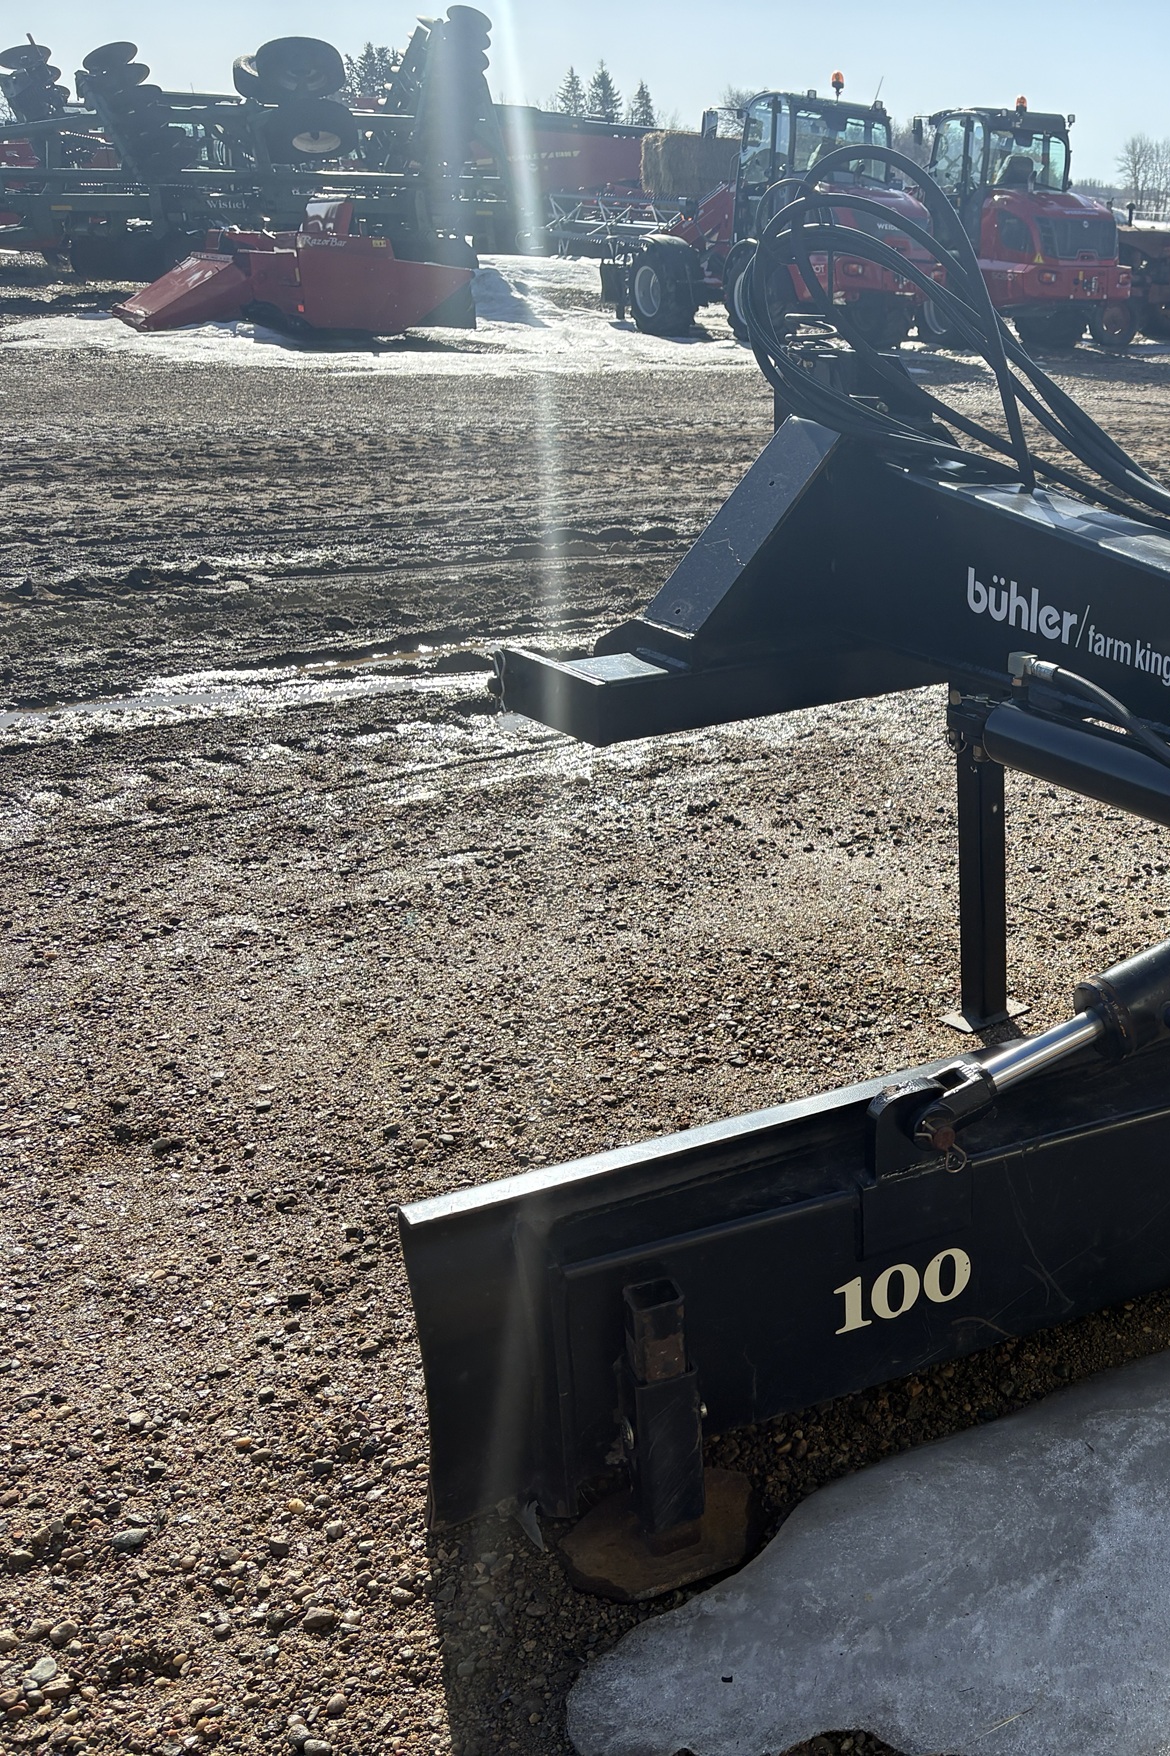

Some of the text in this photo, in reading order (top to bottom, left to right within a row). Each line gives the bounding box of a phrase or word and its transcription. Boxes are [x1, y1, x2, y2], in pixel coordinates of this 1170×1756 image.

[301, 234, 348, 248] RazorBar
[1088, 624, 1132, 665] farm
[833, 1247, 972, 1335] 100
